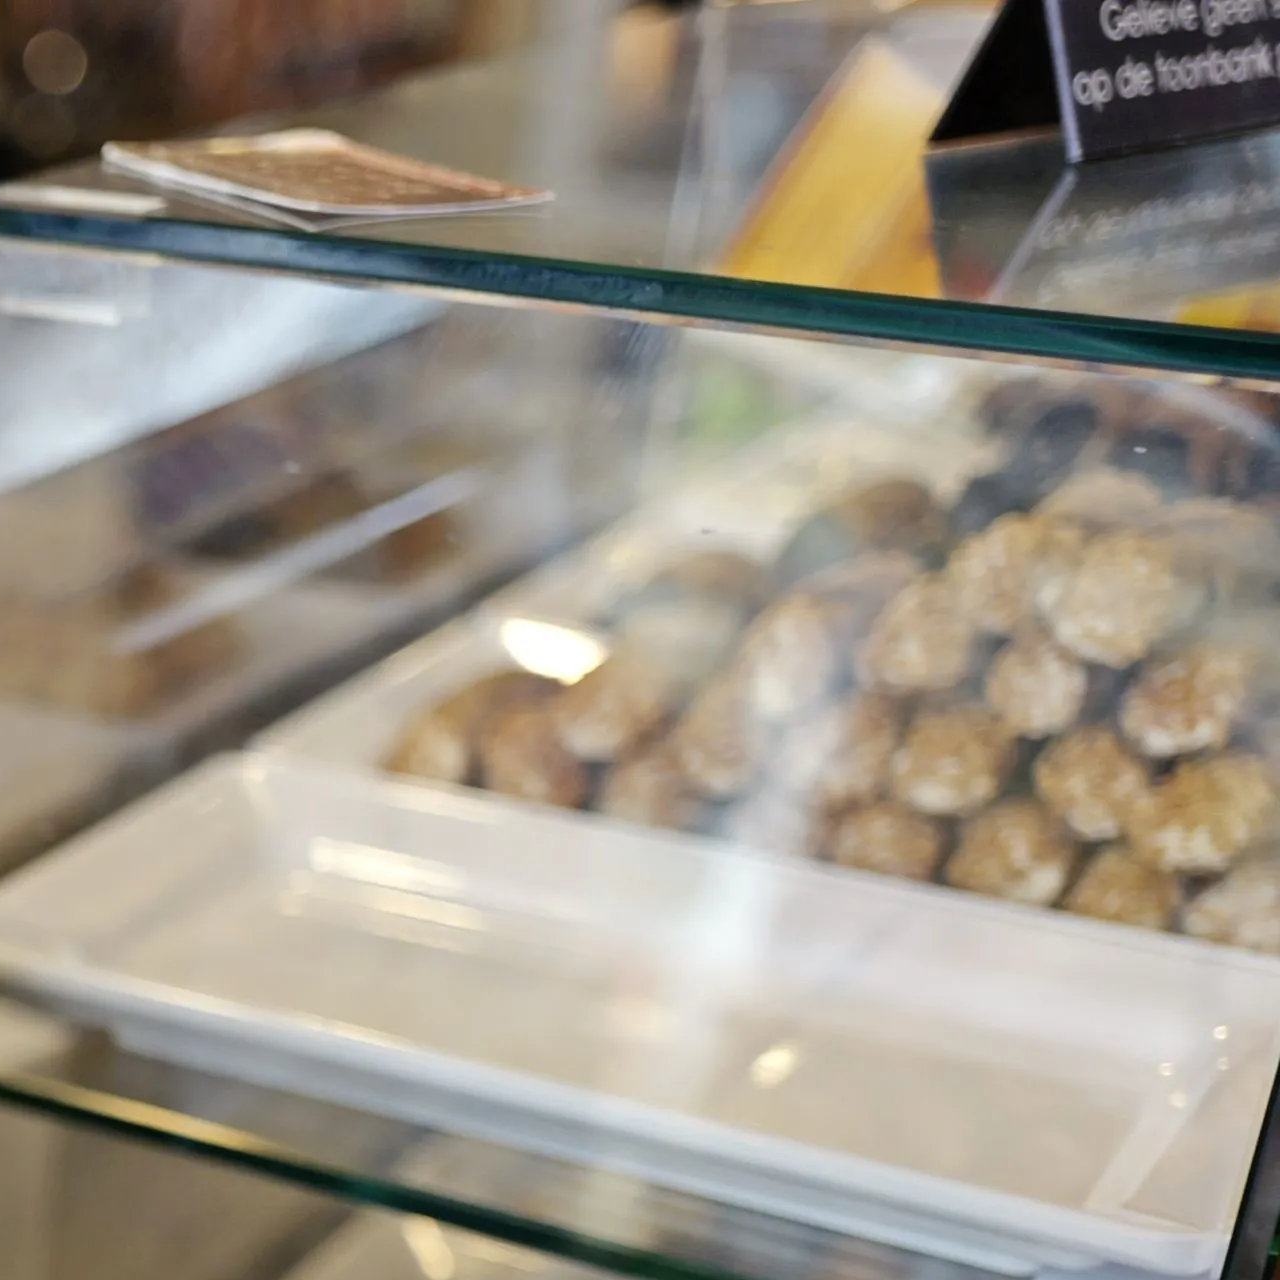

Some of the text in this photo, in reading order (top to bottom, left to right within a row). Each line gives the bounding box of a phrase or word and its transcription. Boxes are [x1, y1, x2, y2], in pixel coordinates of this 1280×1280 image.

[1072, 33, 1275, 112] op de toonbank
